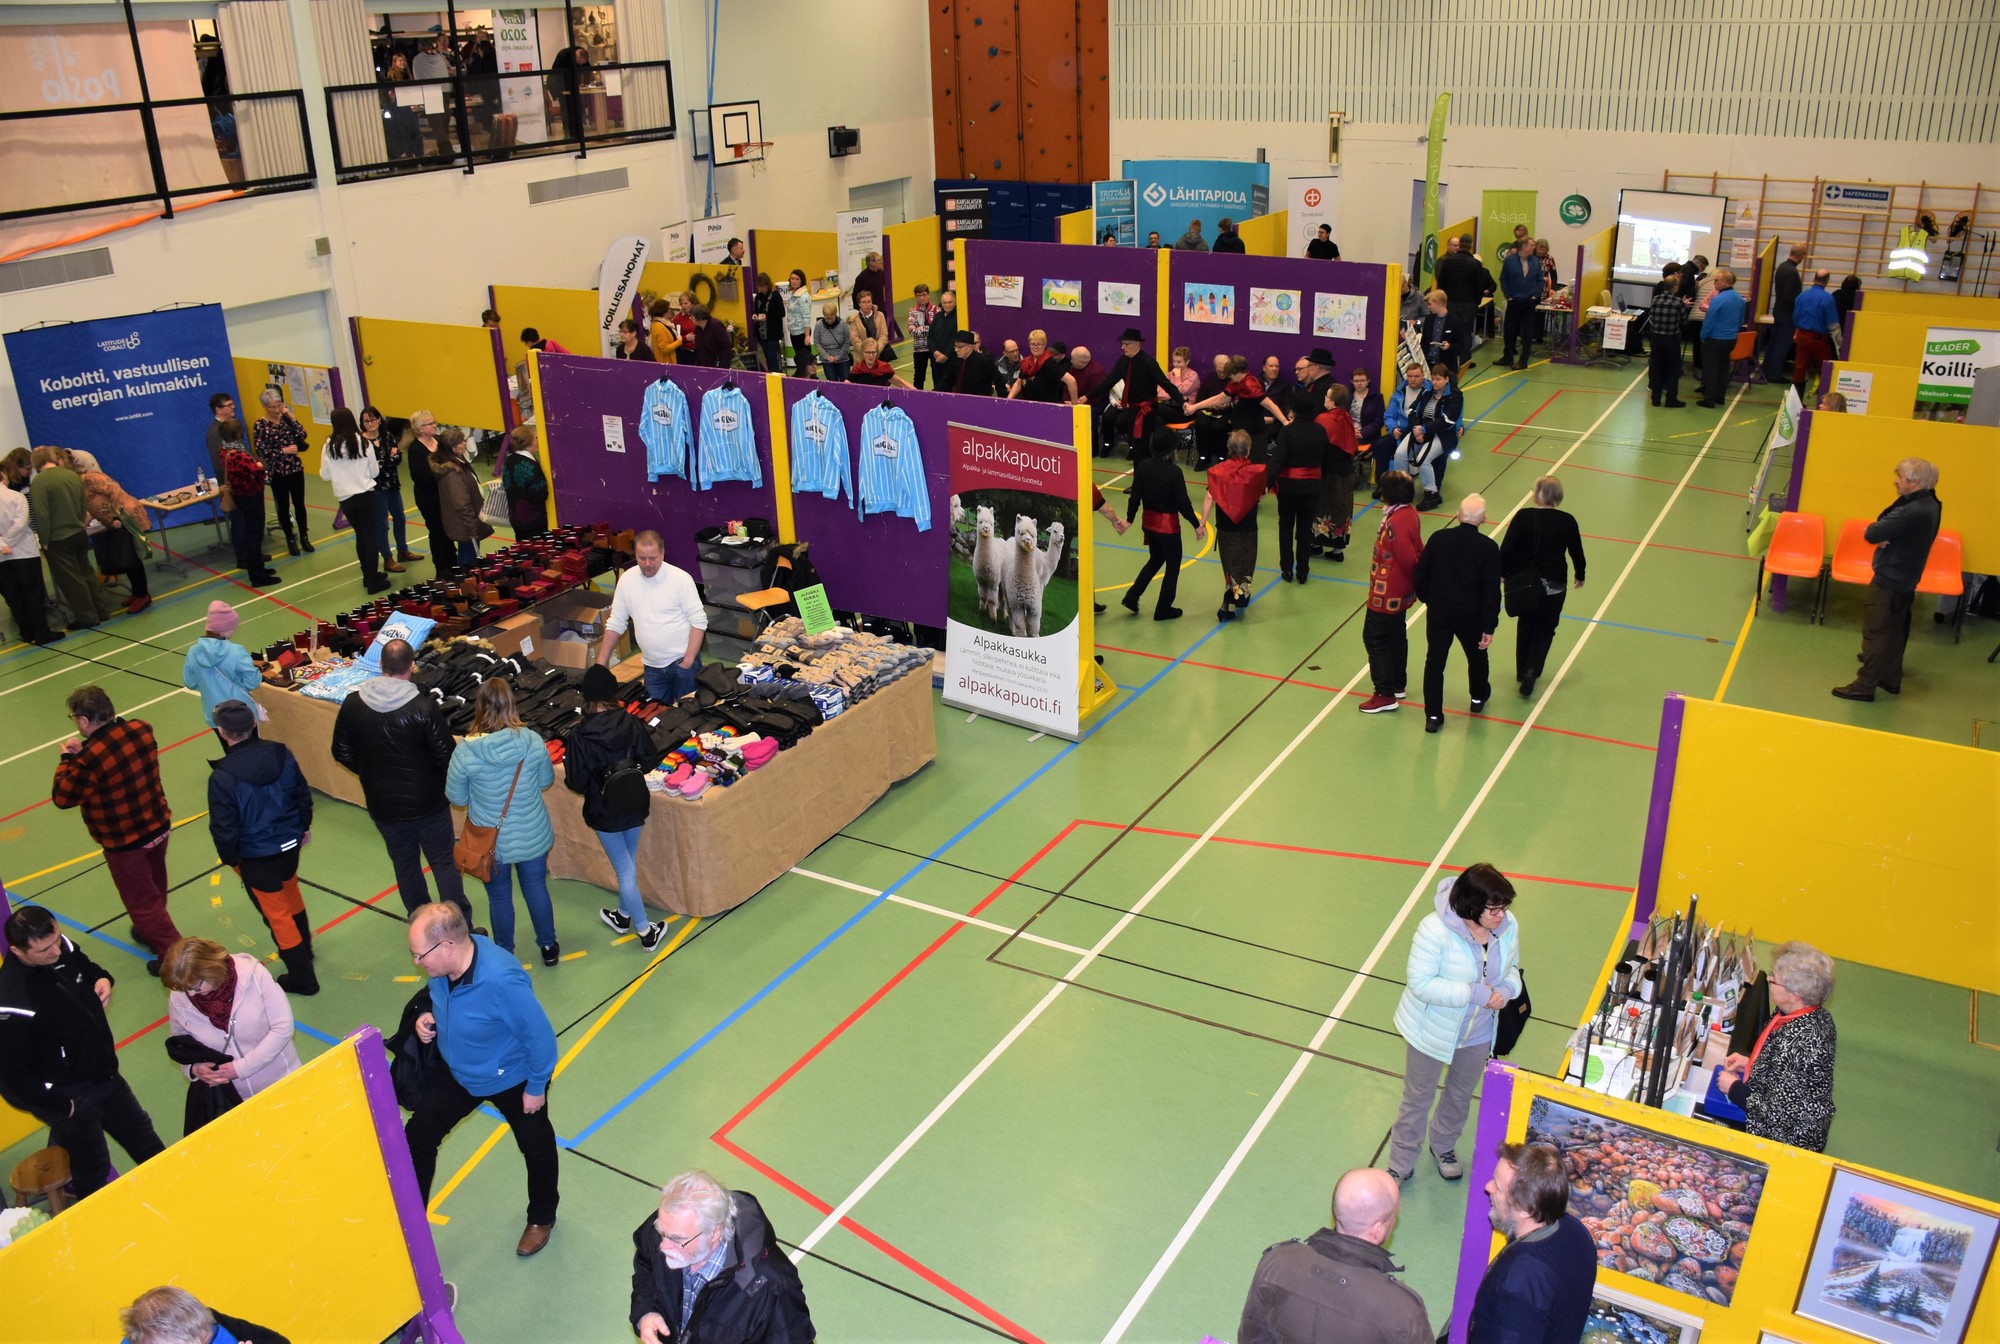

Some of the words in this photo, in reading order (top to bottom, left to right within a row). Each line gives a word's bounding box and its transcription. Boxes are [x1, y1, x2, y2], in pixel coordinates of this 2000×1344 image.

[1169, 186, 1247, 204] LÄHITAPIOLA
[1844, 190, 1887, 199] VAPEPAKESKUS
[851, 216, 869, 225] Pihla
[1488, 209, 1531, 223] Asiaa.
[602, 239, 646, 331] KOILLISSANOMAT
[97, 338, 126, 348] LATITUDE
[103, 343, 127, 352] COBALT
[1929, 342, 1970, 353] LEADER
[40, 369, 110, 393] Koboltti,
[112, 356, 210, 381] vastuullisen
[1922, 361, 1981, 378] Koillis
[51, 388, 123, 411] energian
[125, 372, 207, 398] kulmakivi.
[1918, 390, 1949, 399] rahoitusta
[962, 436, 1061, 475] alpakkapuoti
[960, 646, 982, 659] Lämmin,
[973, 635, 1047, 665] Alpakkasukka
[995, 664, 1017, 676] mukava
[958, 675, 1062, 715] alpakkapuoti.fi
